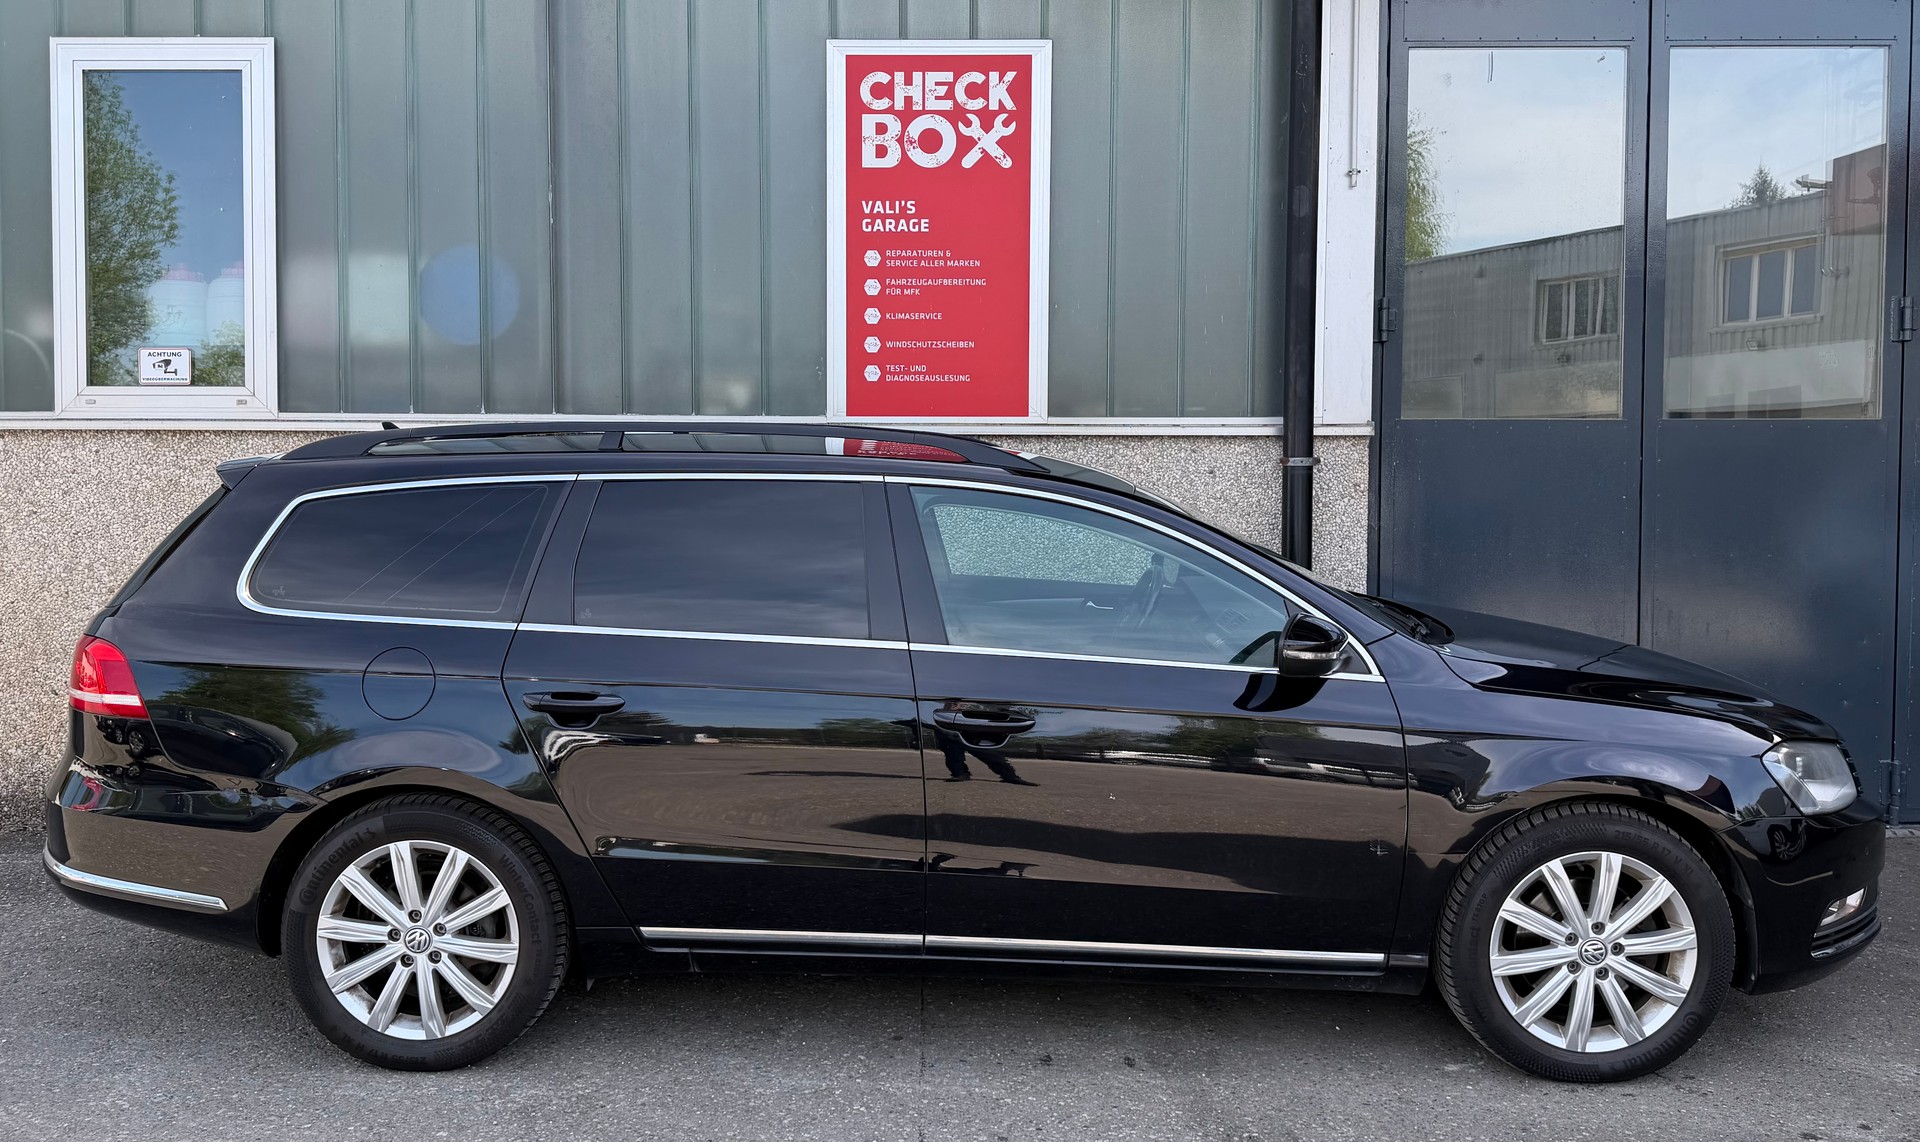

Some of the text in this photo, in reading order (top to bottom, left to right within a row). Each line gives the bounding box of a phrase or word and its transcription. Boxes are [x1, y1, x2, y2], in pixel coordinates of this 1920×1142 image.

[860, 71, 1017, 110] CHECK
[861, 113, 1017, 169] BOX
[862, 200, 916, 214] VALI'S
[862, 218, 929, 232] GARAGE
[299, 831, 365, 906] Continental
[498, 852, 543, 944] WinterContact
